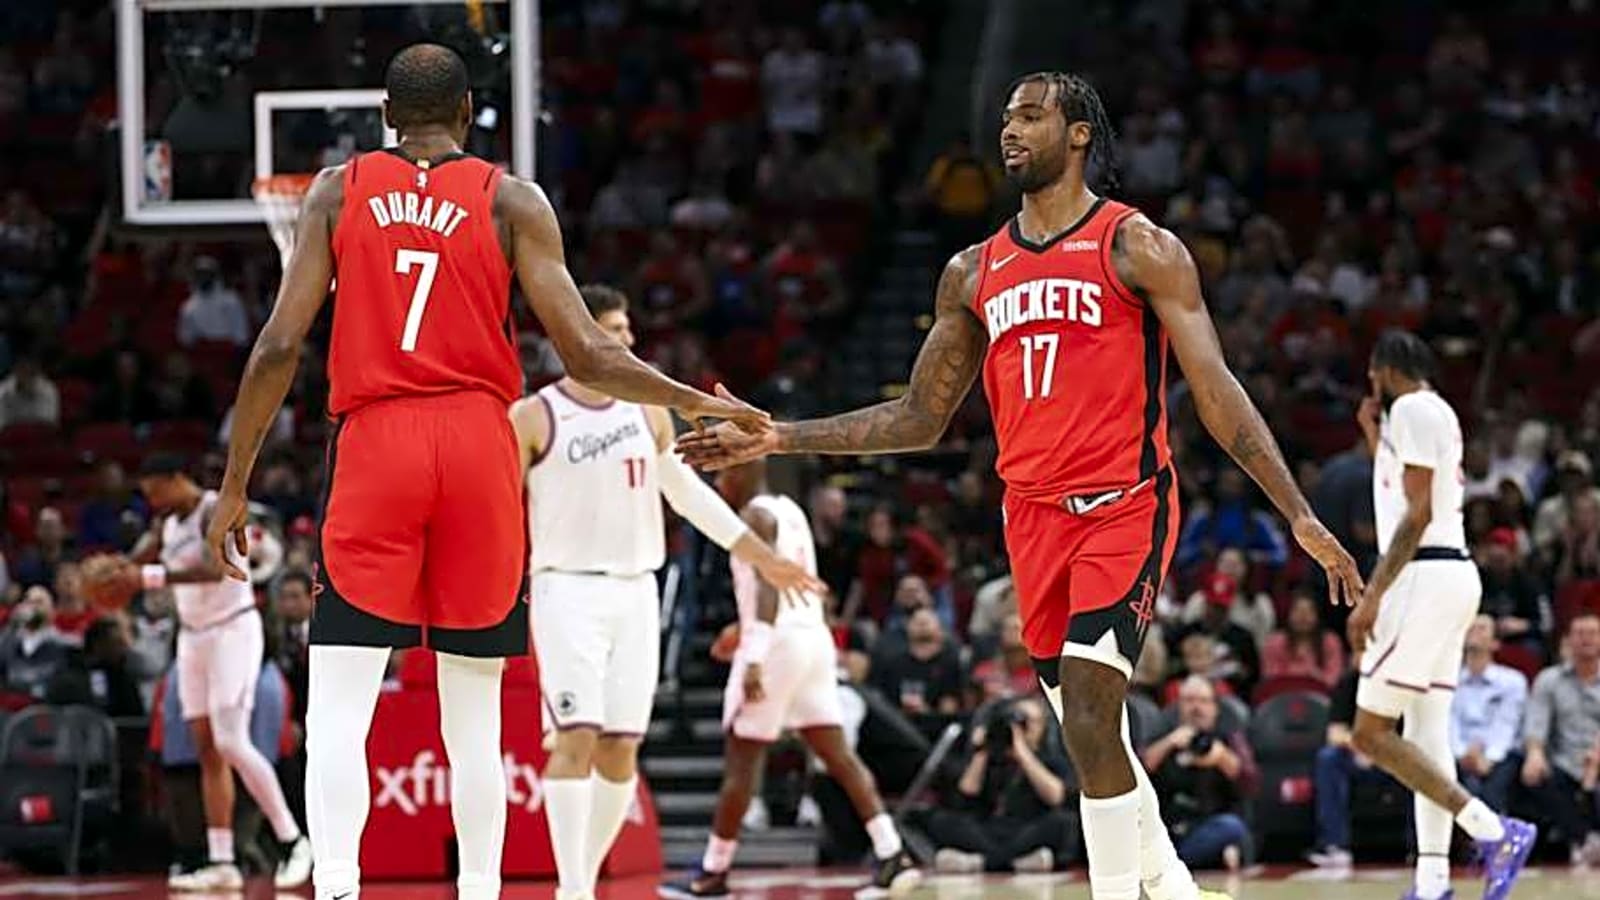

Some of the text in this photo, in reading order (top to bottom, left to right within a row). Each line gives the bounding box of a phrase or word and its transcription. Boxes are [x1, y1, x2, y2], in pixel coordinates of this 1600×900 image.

[368, 191, 469, 237] DURANT
[394, 248, 439, 352] 7
[984, 278, 1102, 343] ROCKETS
[1019, 333, 1060, 400] 17
[623, 458, 647, 489] 11
[375, 750, 544, 815] xfity
